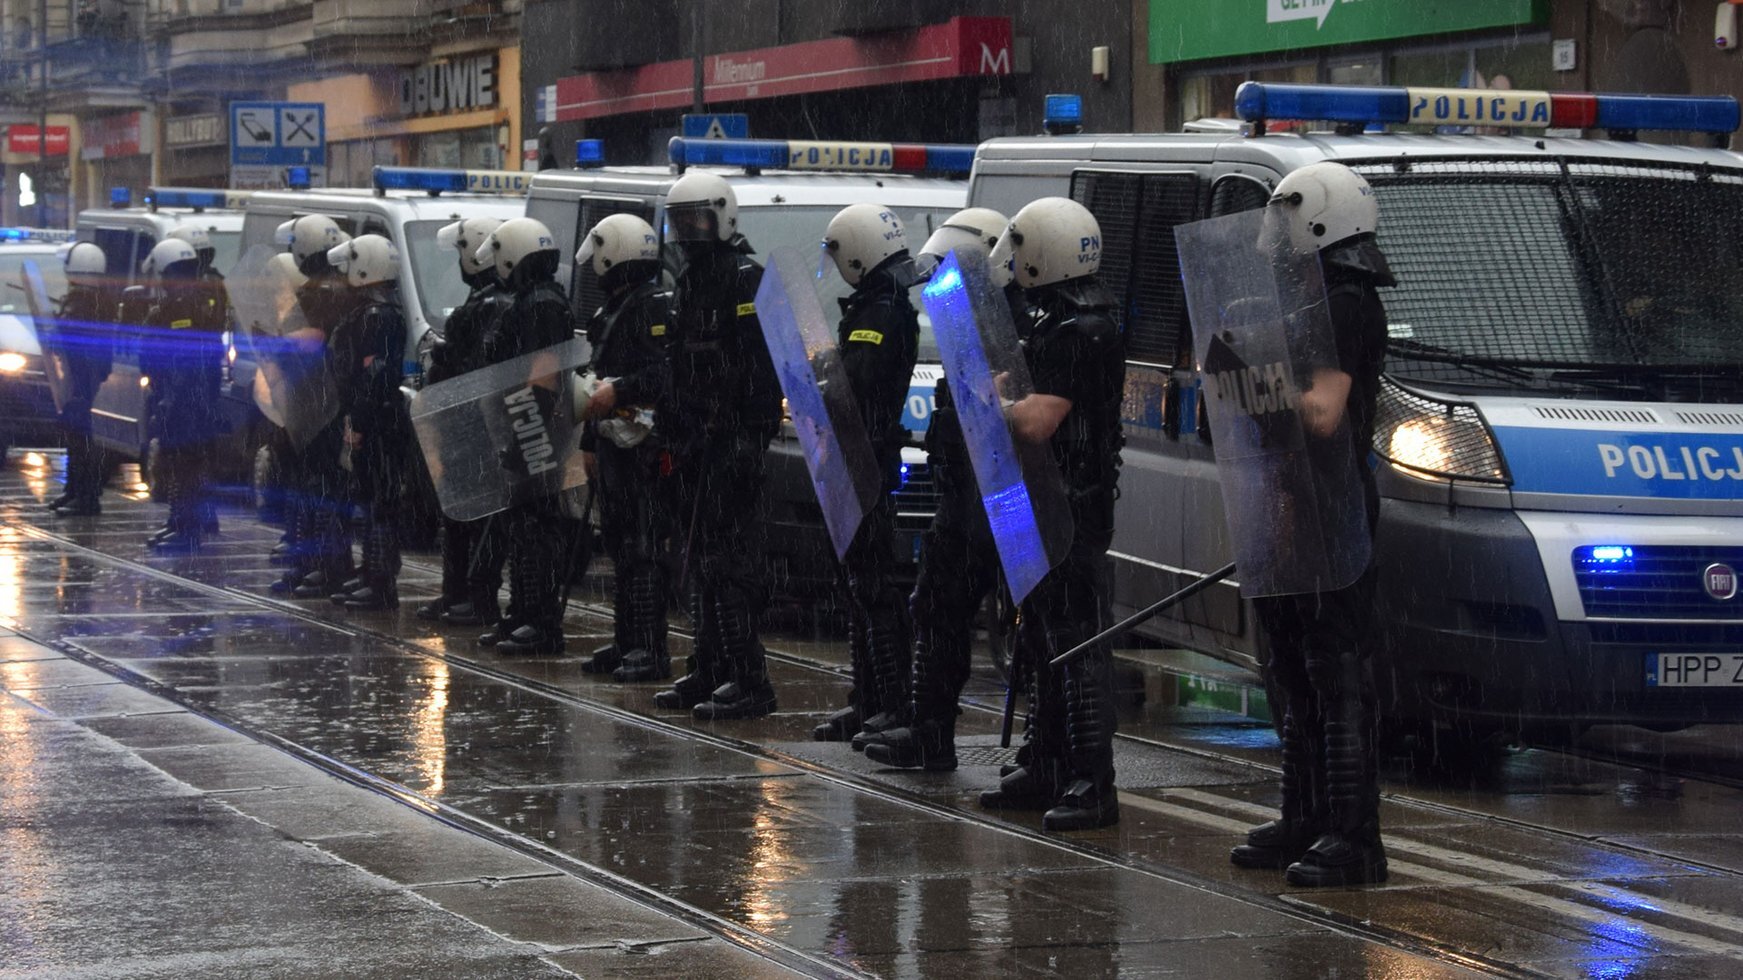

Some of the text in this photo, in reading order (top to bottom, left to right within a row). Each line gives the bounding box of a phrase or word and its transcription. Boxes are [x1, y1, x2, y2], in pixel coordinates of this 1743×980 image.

[980, 42, 1010, 74] M
[400, 55, 493, 116] OBUWIE
[1412, 95, 1548, 122] POLICJA
[791, 146, 891, 167] POLICJA
[469, 174, 530, 189] POLIC
[1080, 235, 1099, 252] PN
[504, 386, 558, 475] POLICJA
[1711, 574, 1730, 590] FIAT
[1663, 655, 1721, 684] HPP
